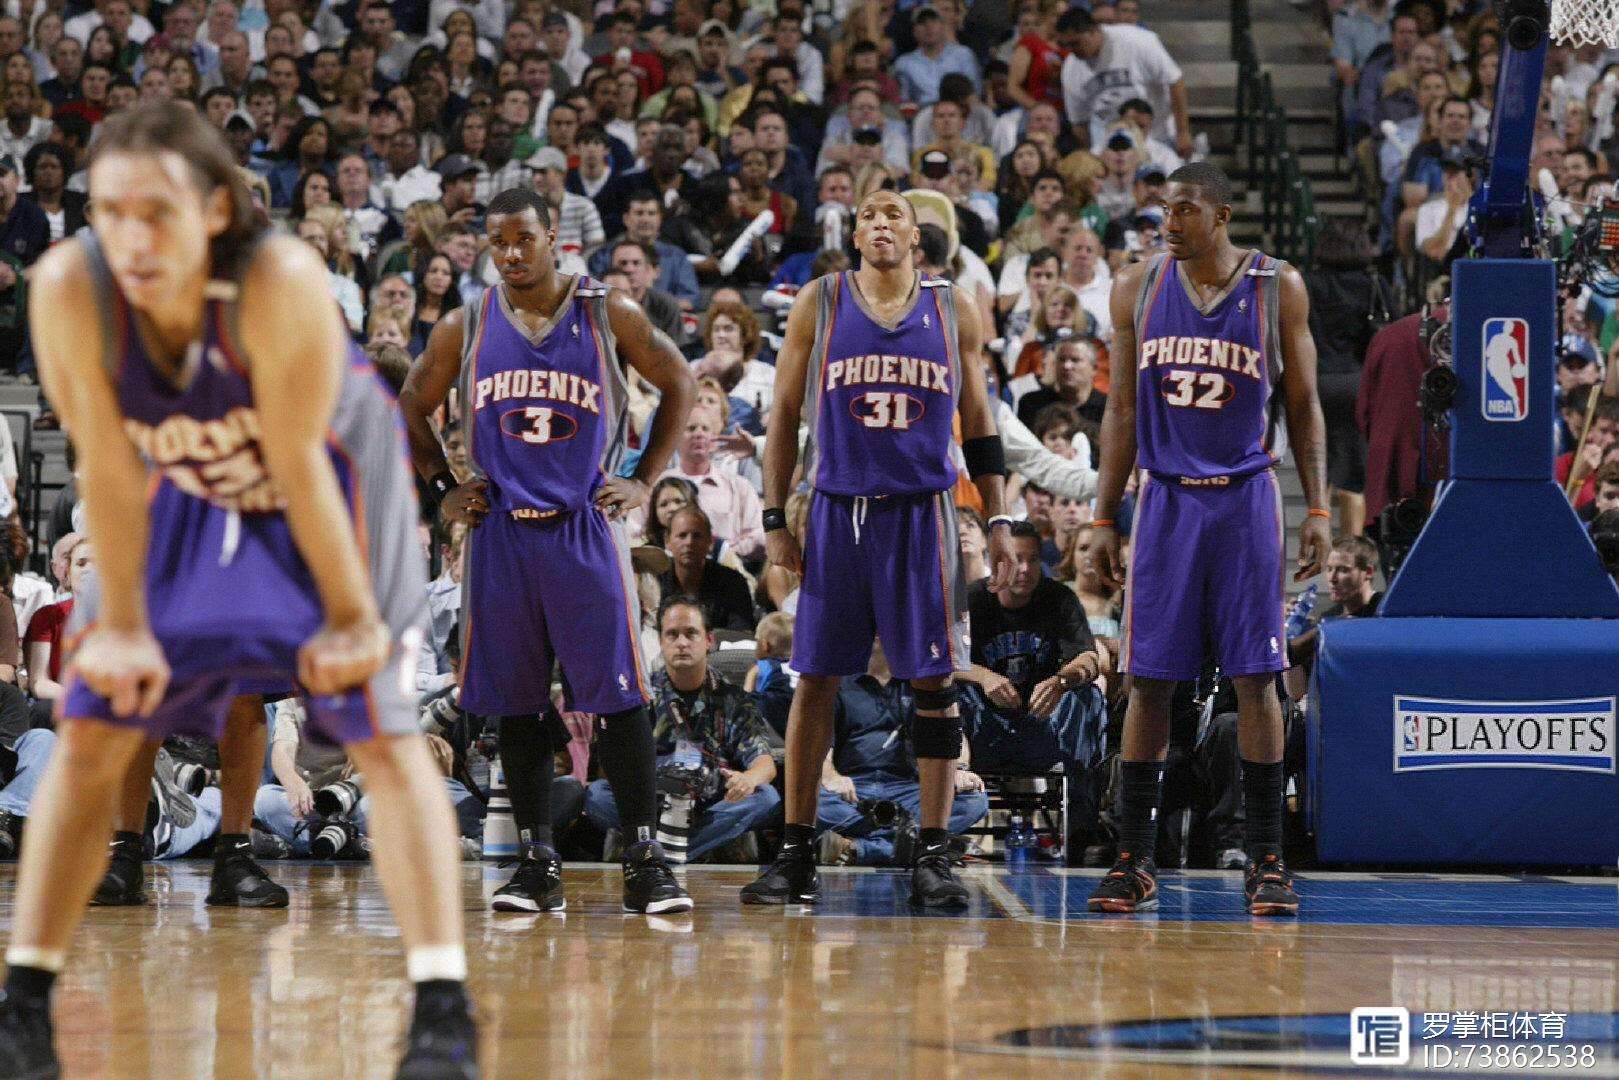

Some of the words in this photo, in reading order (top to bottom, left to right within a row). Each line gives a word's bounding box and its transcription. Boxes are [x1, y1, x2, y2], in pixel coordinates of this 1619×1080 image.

[827, 354, 950, 396] PHOENIX
[1139, 336, 1261, 380] PHOENIX
[475, 369, 600, 414] PHOENIX
[1166, 369, 1225, 409] 32
[1487, 399, 1514, 414] NBA
[521, 406, 553, 444] 3
[863, 391, 909, 430] 31
[1426, 715, 1608, 752] PLAYOFFS
